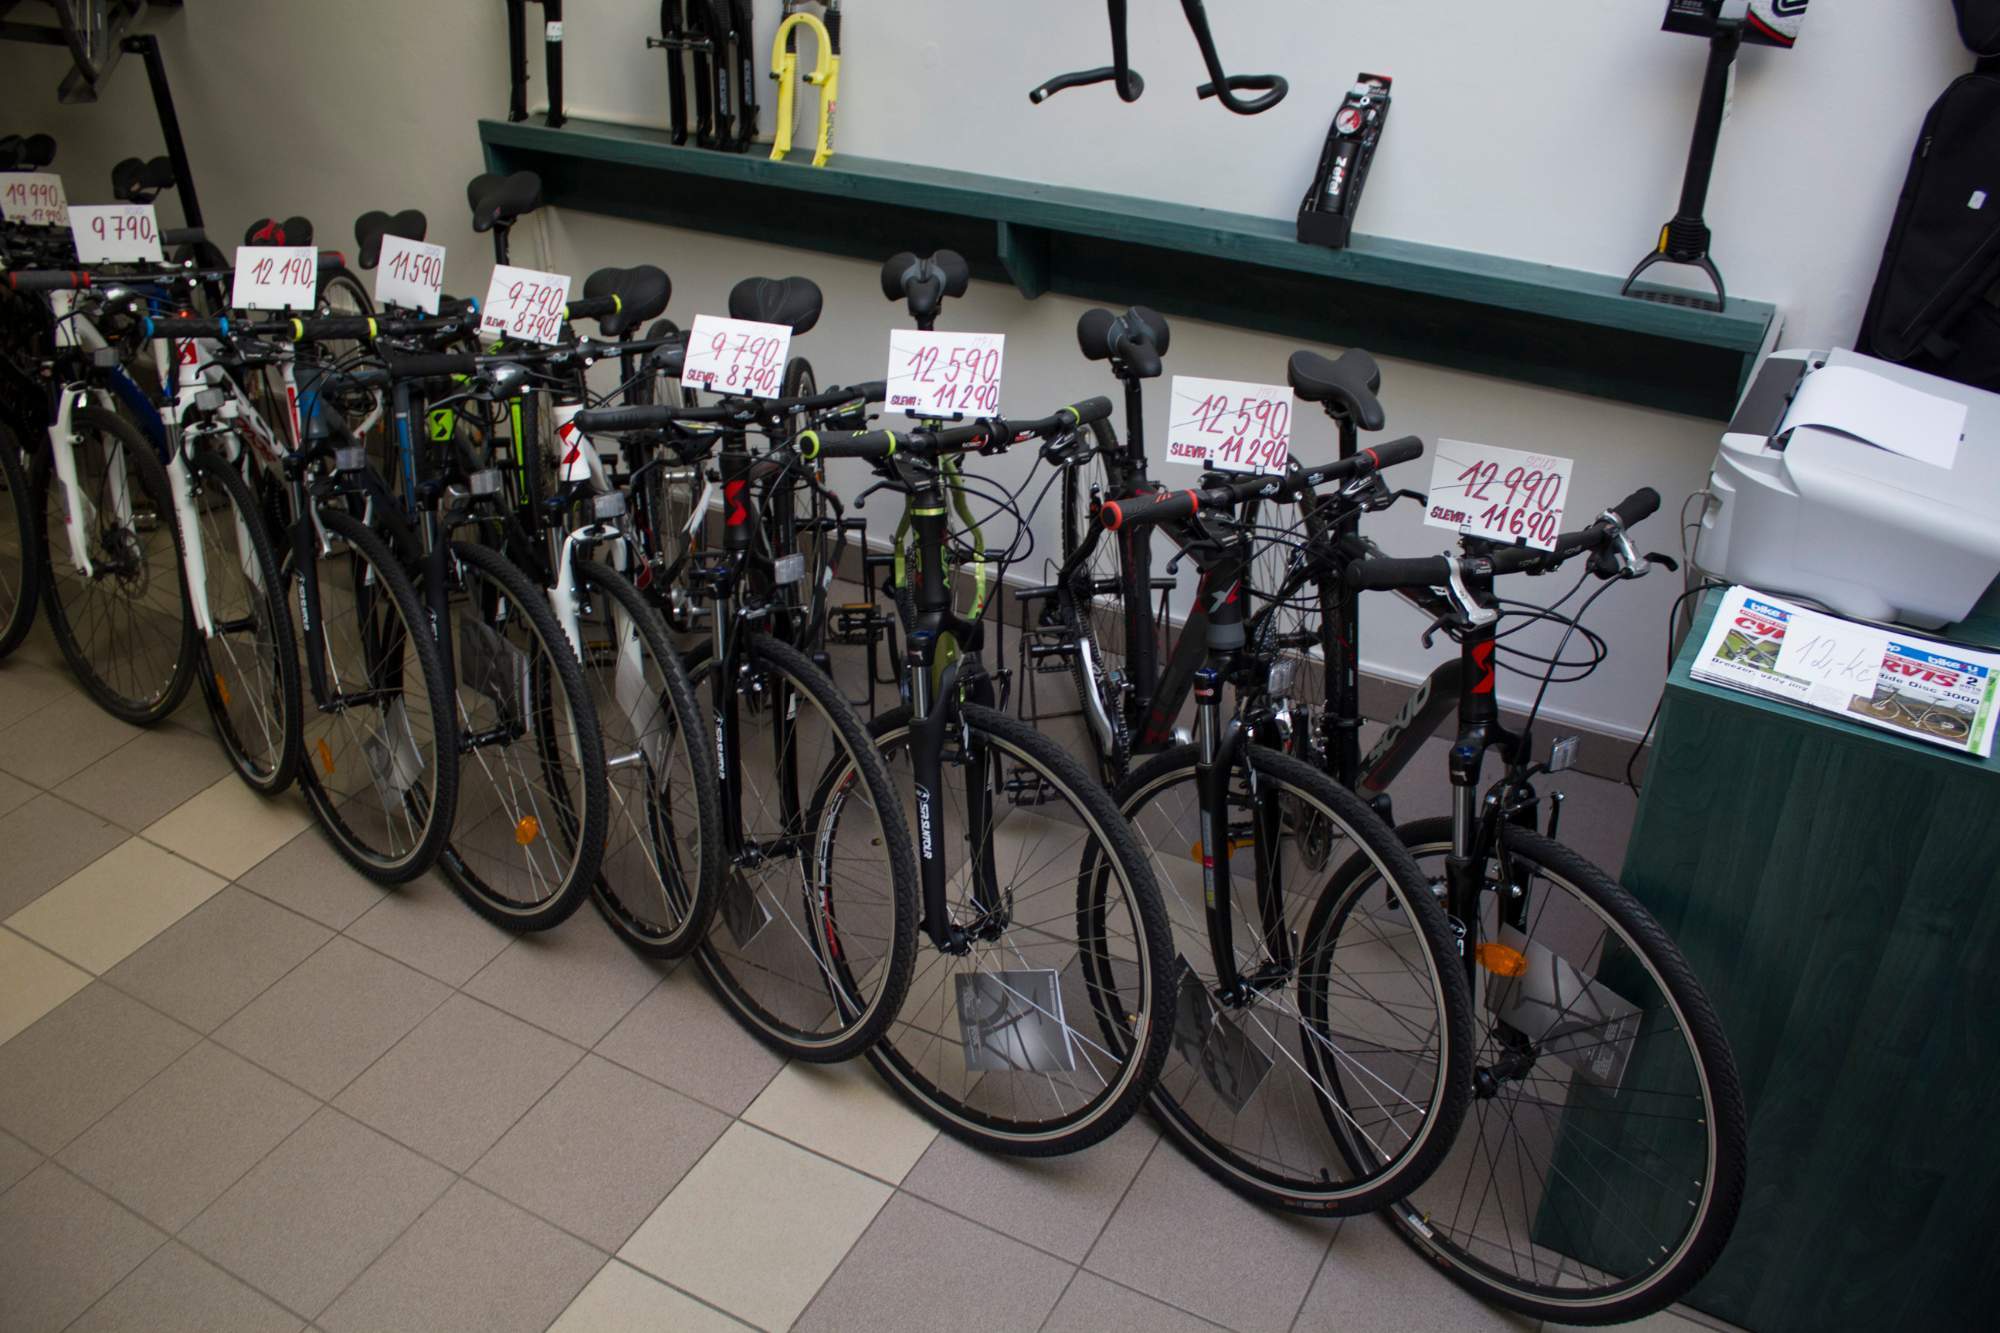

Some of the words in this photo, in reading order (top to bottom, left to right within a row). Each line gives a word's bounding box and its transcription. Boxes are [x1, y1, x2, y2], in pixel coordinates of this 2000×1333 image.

[251, 257, 274, 285] 12
[907, 346, 939, 382] 12
[1192, 394, 1228, 434] 12
[1457, 460, 1499, 501] 12
[1966, 676, 1979, 687] 2
[919, 802, 930, 820] SR
